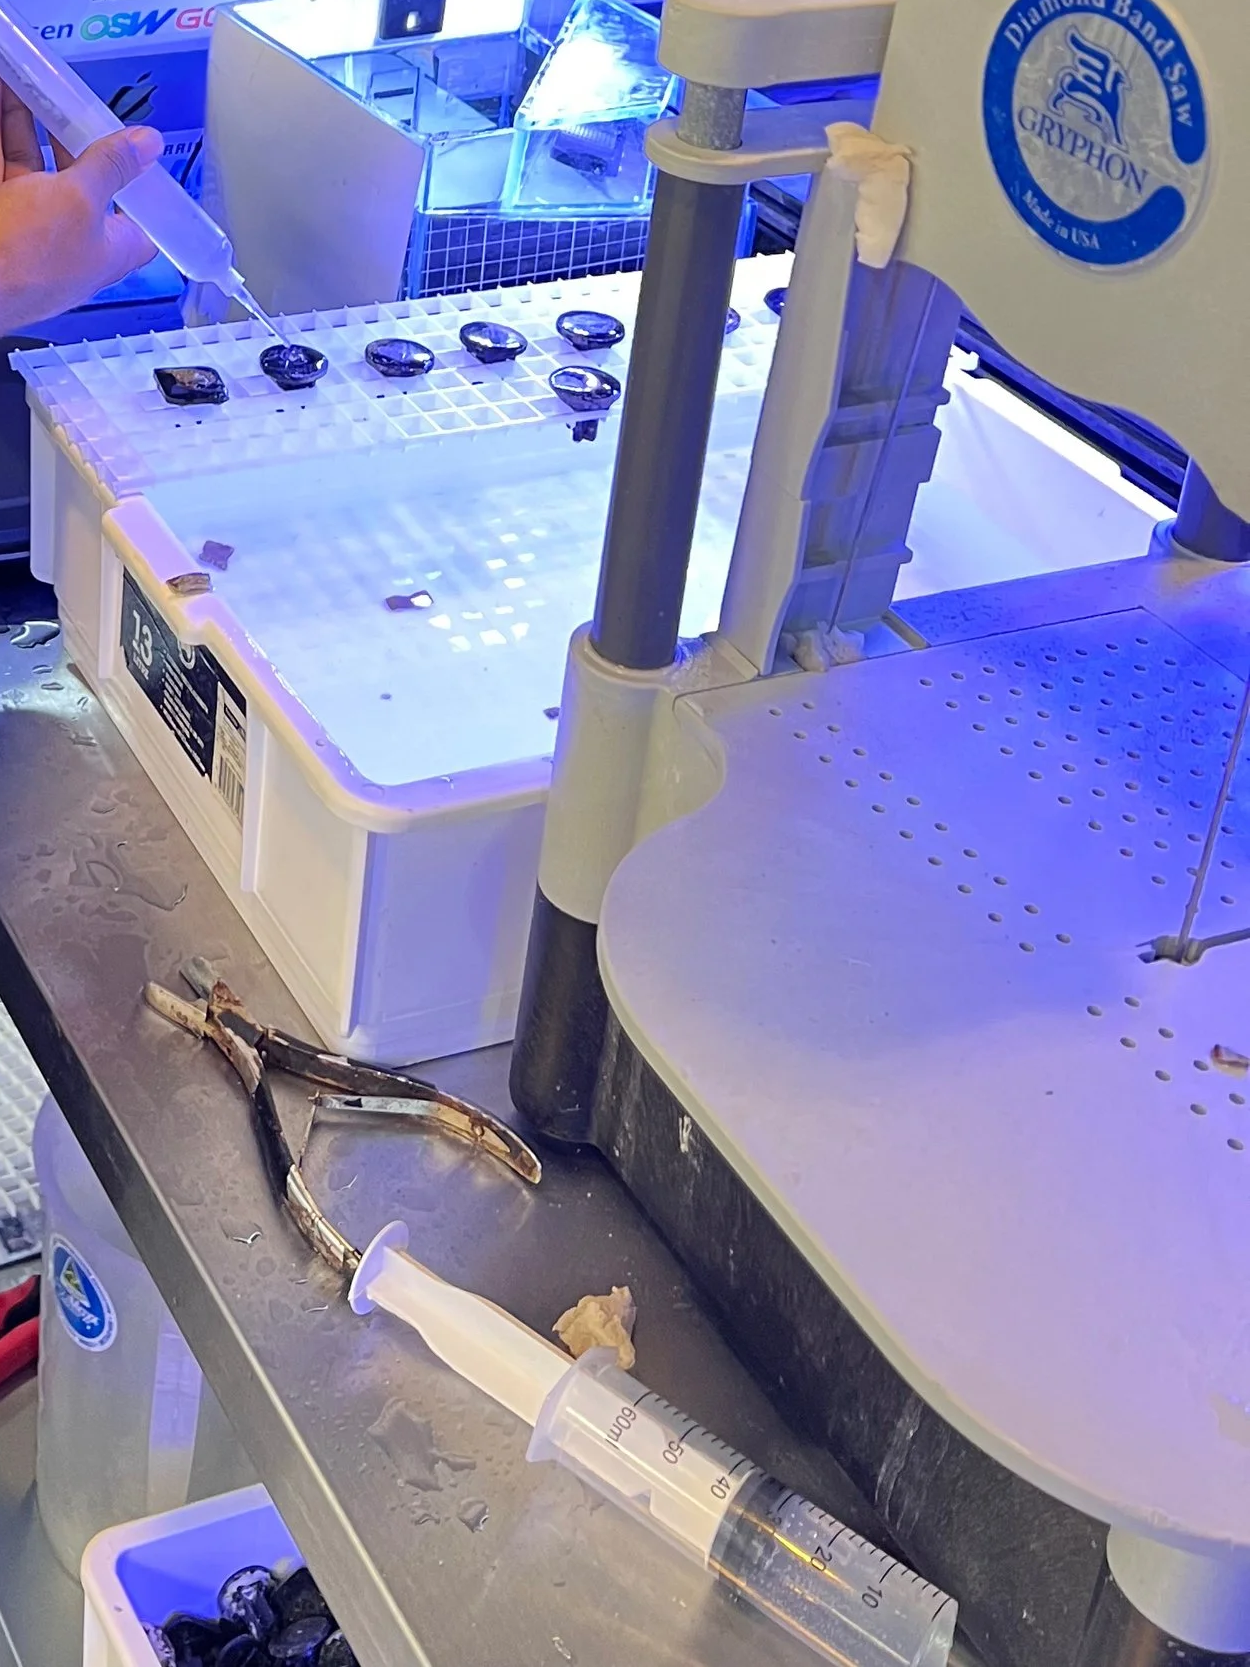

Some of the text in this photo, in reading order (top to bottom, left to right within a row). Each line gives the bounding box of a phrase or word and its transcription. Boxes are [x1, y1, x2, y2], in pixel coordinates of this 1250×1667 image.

[80, 8, 177, 41] OSW
[1165, 62, 1193, 127] Saw
[1018, 106, 1147, 194] GRYPHON
[1022, 190, 1100, 249] Made in USA
[132, 610, 153, 666] 13
[606, 1406, 638, 1450] 60ml
[662, 1439, 684, 1465] 50
[710, 1473, 732, 1500] 40
[810, 1545, 833, 1573] 20
[860, 1583, 884, 1611] 10
